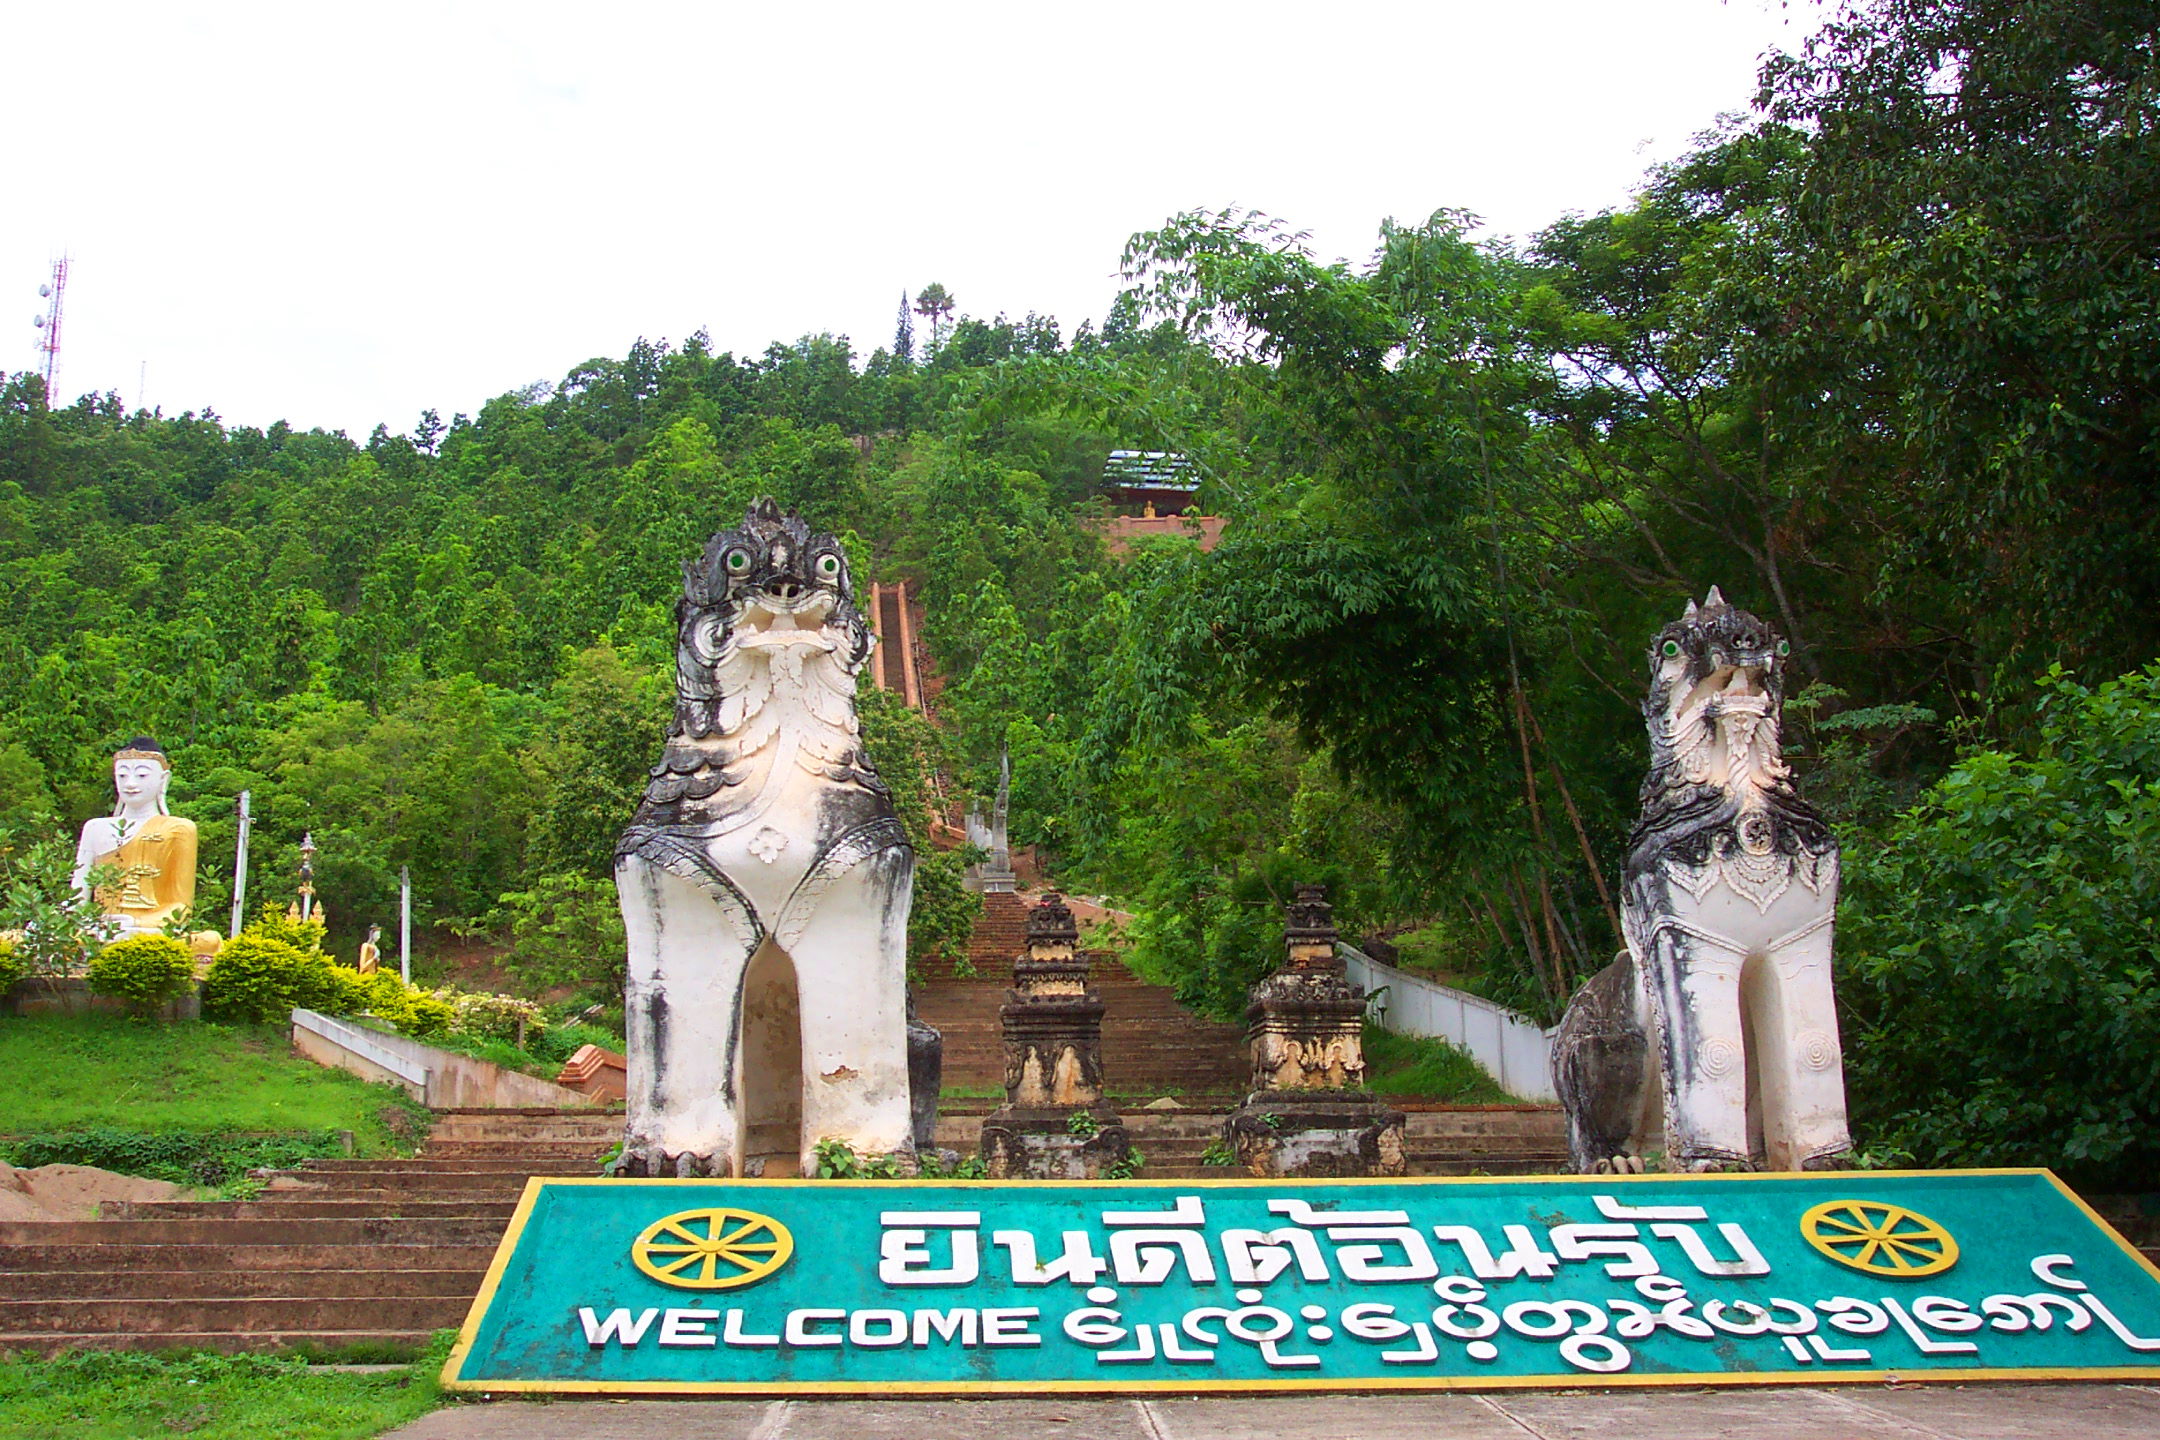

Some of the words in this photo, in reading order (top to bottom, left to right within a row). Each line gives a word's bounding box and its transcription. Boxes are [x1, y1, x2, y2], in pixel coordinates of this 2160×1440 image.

[878, 1195, 1771, 1285] ยินดีต้อนรับ
[577, 1306, 1042, 1348] WELCOME
